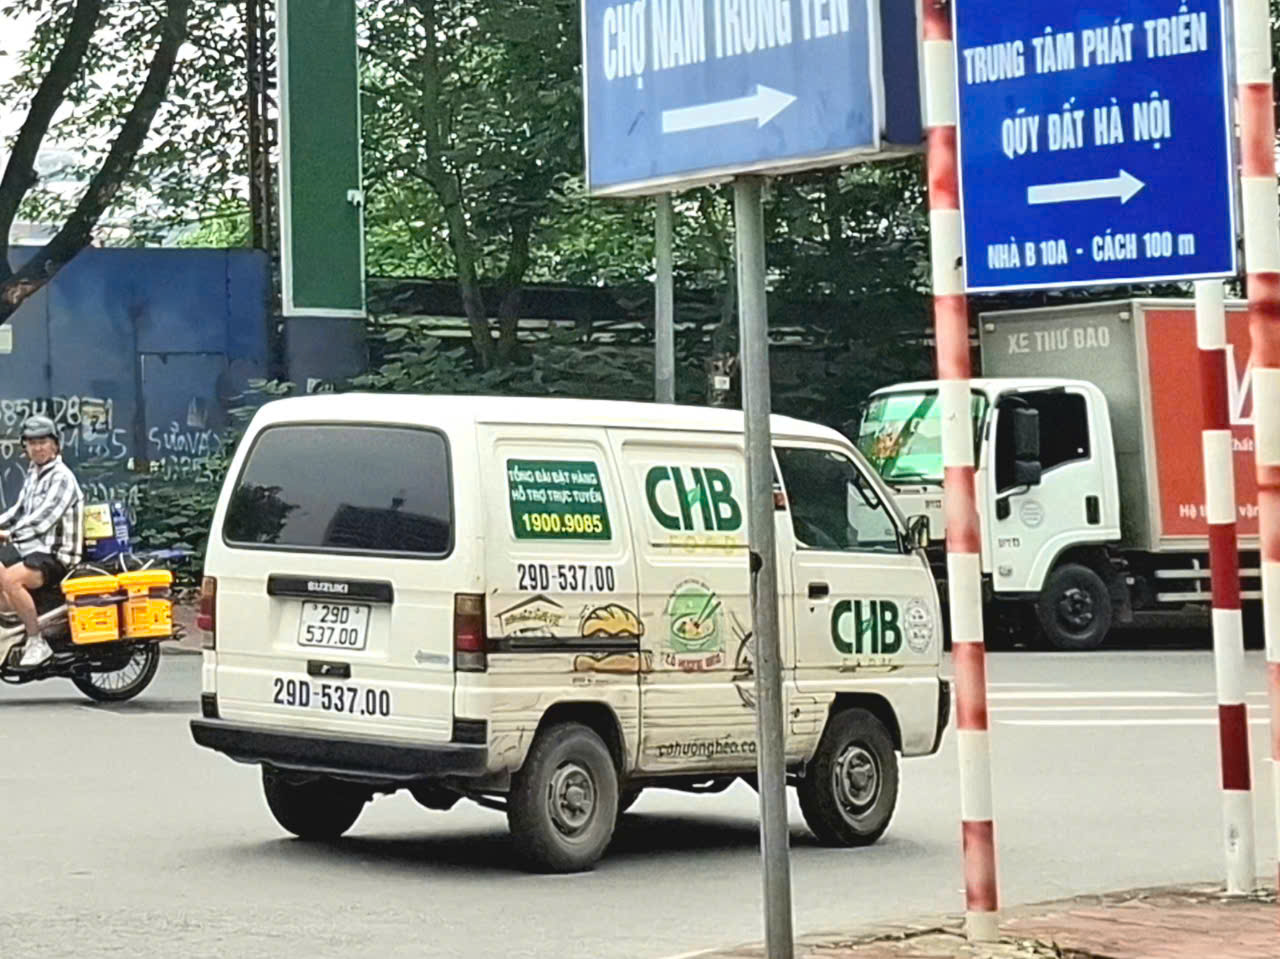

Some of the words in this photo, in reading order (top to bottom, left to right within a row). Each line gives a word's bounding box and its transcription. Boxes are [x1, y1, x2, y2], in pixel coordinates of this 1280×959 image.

[963, 40, 1025, 85] TRUNG
[1033, 26, 1075, 74] TÂM
[1083, 19, 1134, 67] PHÁT
[1047, 96, 1084, 151] ĐẤT
[1093, 97, 1124, 146] HÀ
[1132, 90, 1171, 150] NỘI
[987, 236, 1020, 269] NHÀ
[1025, 242, 1036, 266] B
[1039, 239, 1068, 265] 10A
[1092, 228, 1137, 261] CÁCH
[1142, 231, 1172, 258] 100
[1178, 233, 1195, 255] m
[1008, 332, 1030, 354] XE
[1034, 327, 1070, 352] THƯ
[645, 465, 743, 531] CHB
[522, 513, 603, 533] 1900.9085
[307, 581, 348, 594] SUZUKI
[517, 563, 616, 592] 29D-537.00
[320, 605, 349, 624] 29D
[831, 600, 902, 654] CHB
[305, 625, 358, 646] 537.00
[273, 677, 391, 717] 29D-537.00
